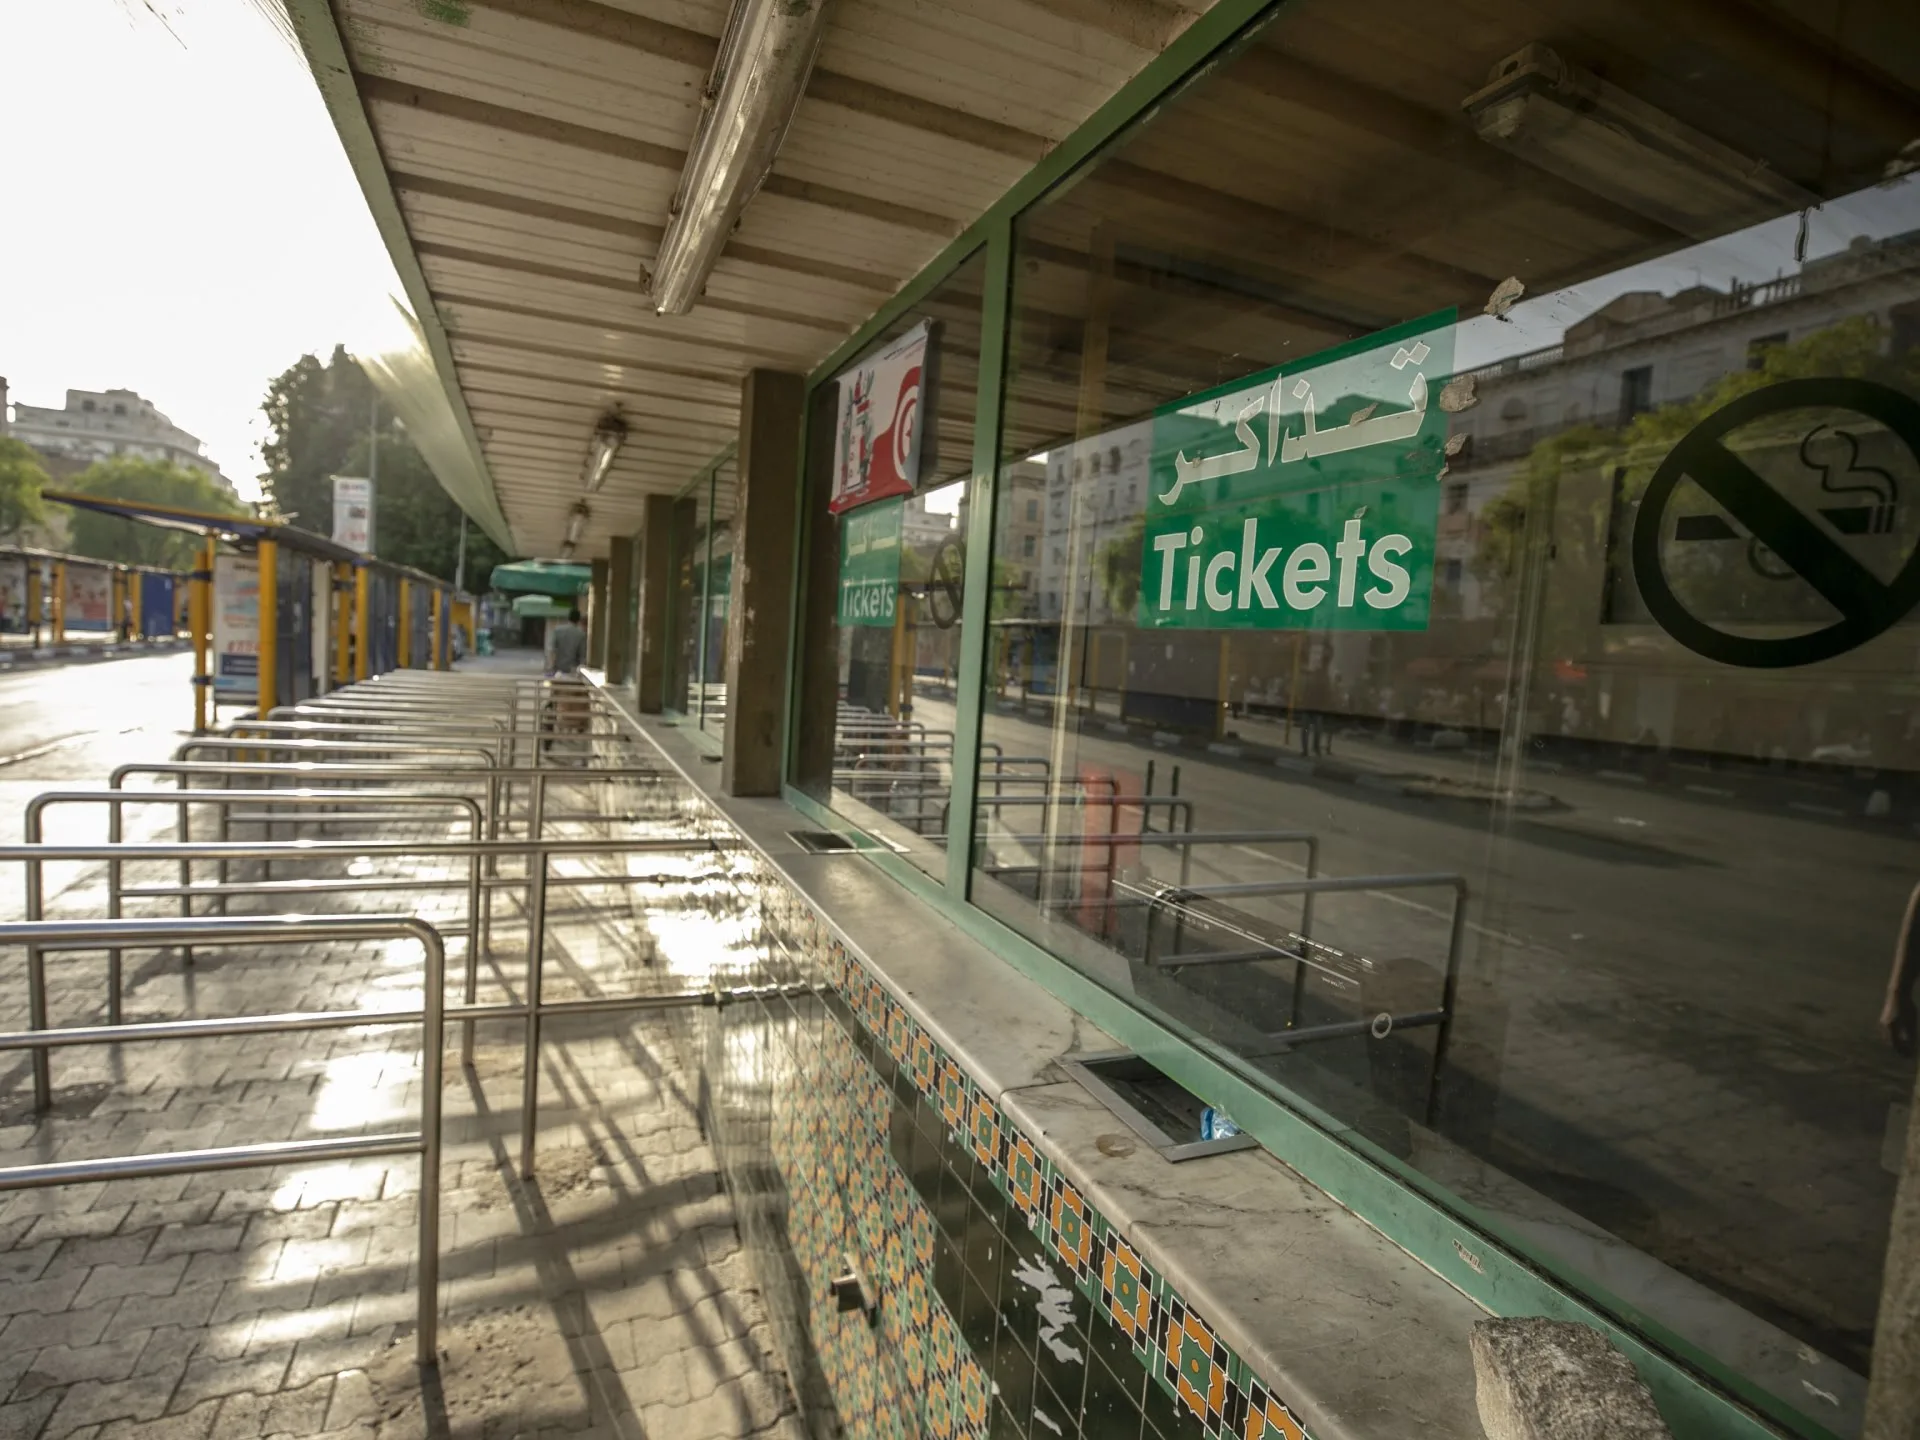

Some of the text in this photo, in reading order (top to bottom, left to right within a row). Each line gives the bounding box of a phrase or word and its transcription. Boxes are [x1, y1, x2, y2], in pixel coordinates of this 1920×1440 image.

[1157, 341, 1430, 506] تذاكر
[842, 577, 895, 618] Tickets
[1153, 517, 1413, 612] Tickets
